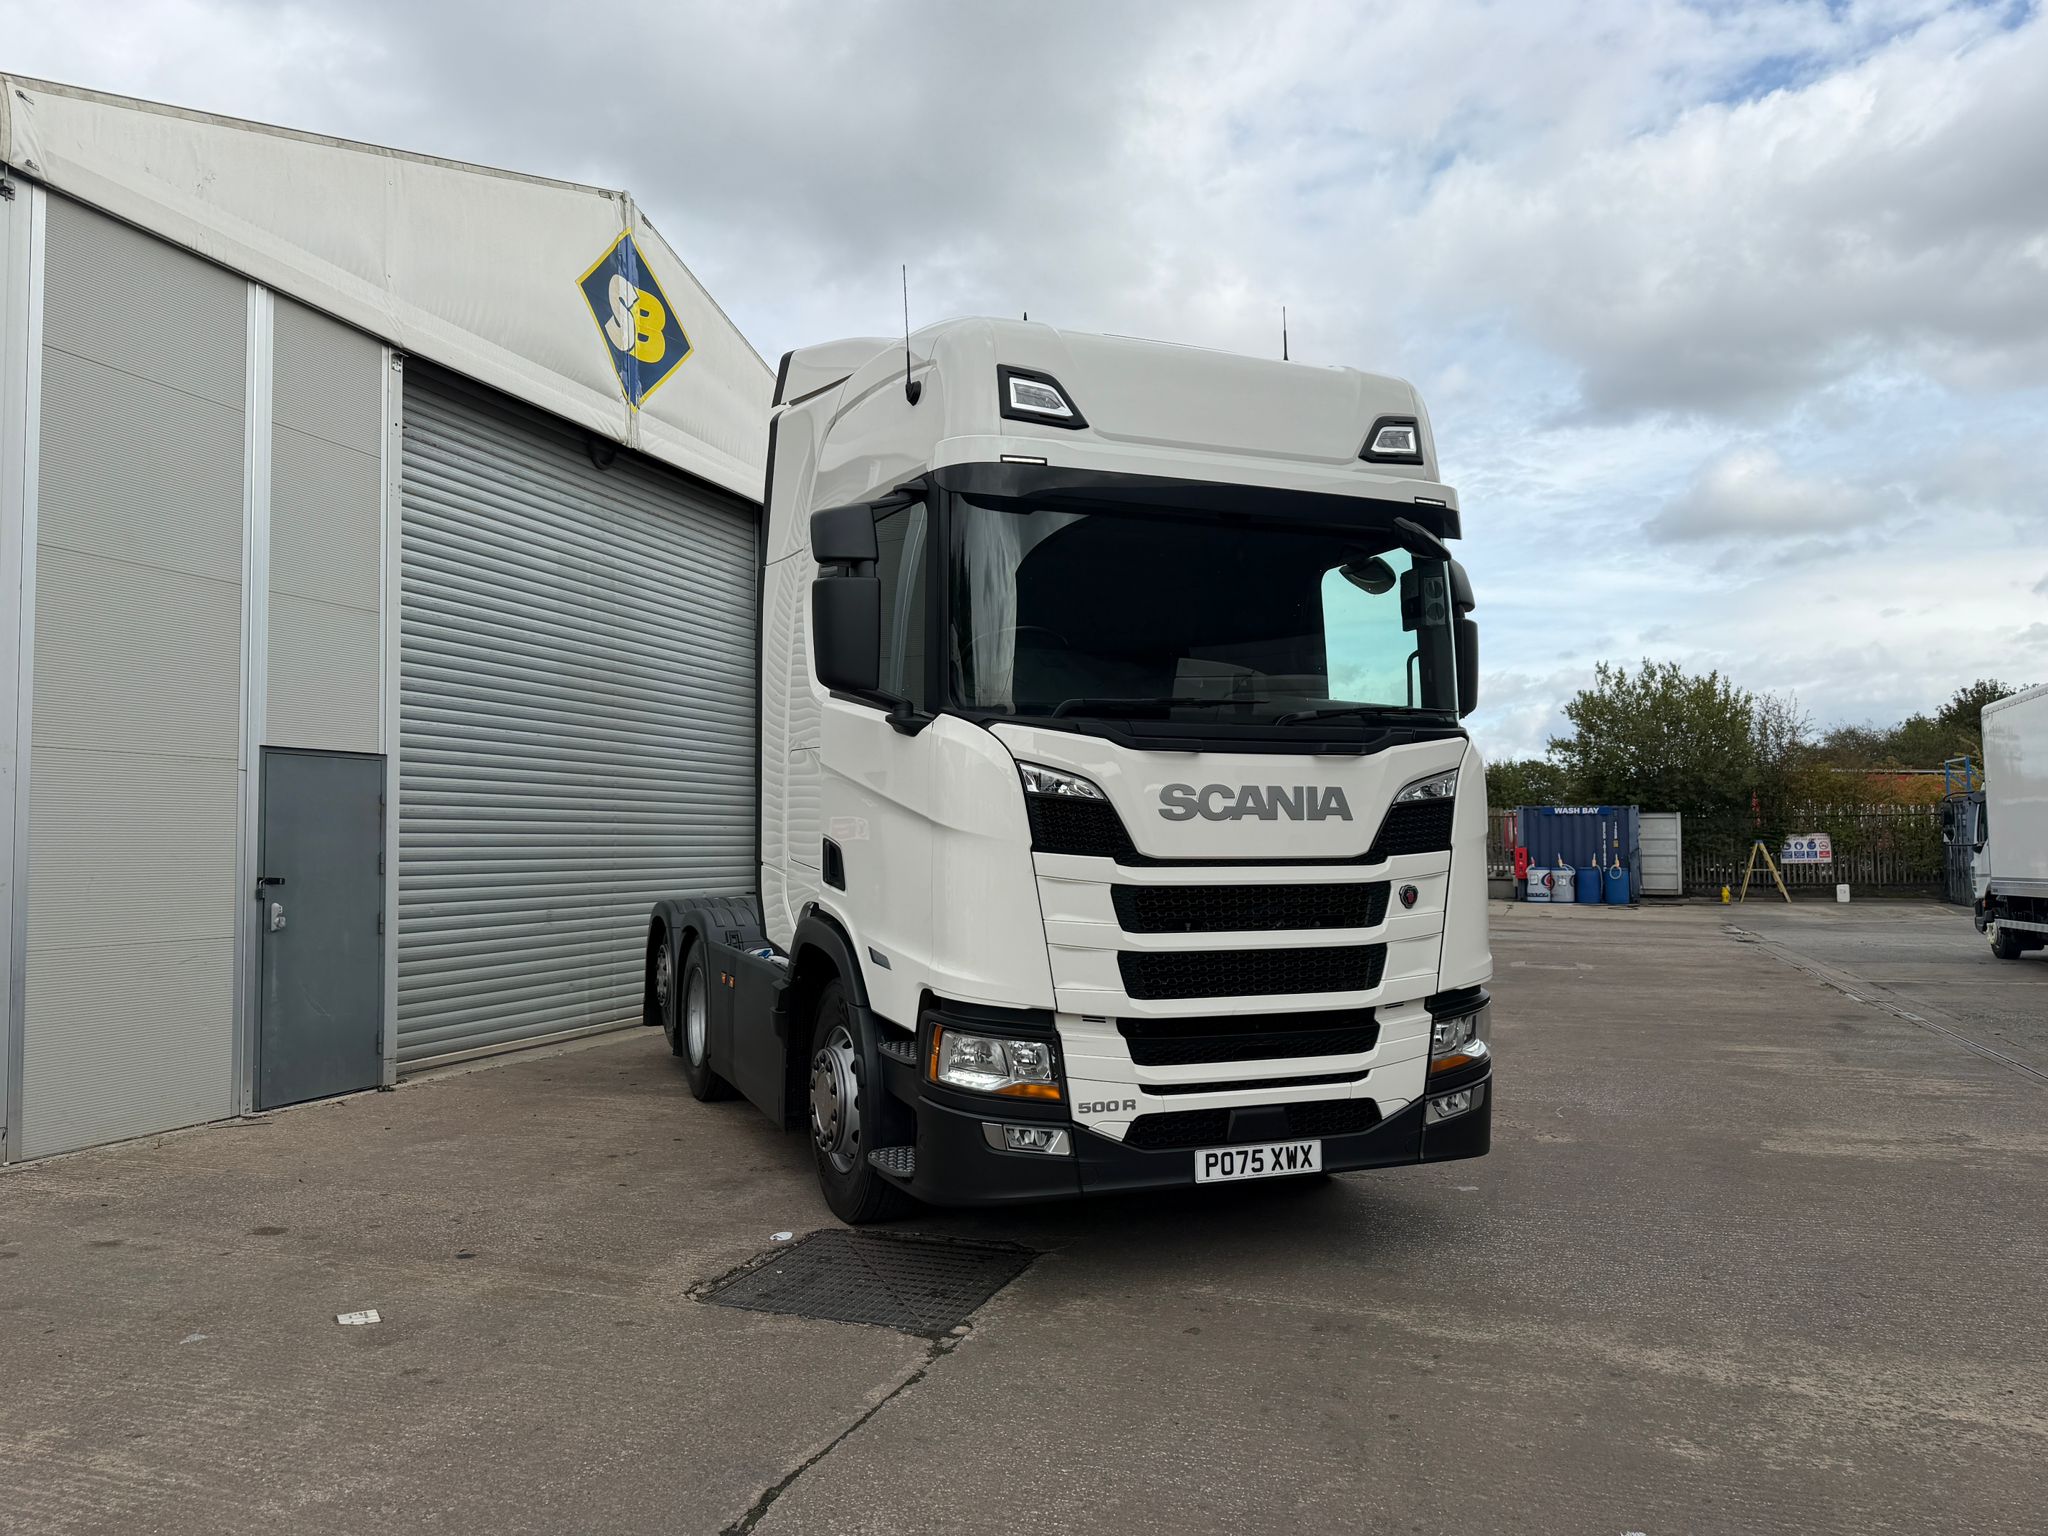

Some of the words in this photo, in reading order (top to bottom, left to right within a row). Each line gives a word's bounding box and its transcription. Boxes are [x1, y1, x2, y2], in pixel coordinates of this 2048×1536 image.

[604, 273, 666, 363] SB
[1158, 783, 1353, 821] SCANIA
[1078, 1100, 1120, 1114] 500
[1122, 1099, 1137, 1111] R
[1205, 1149, 1264, 1178] PO75
[1271, 1144, 1313, 1172] XWX
